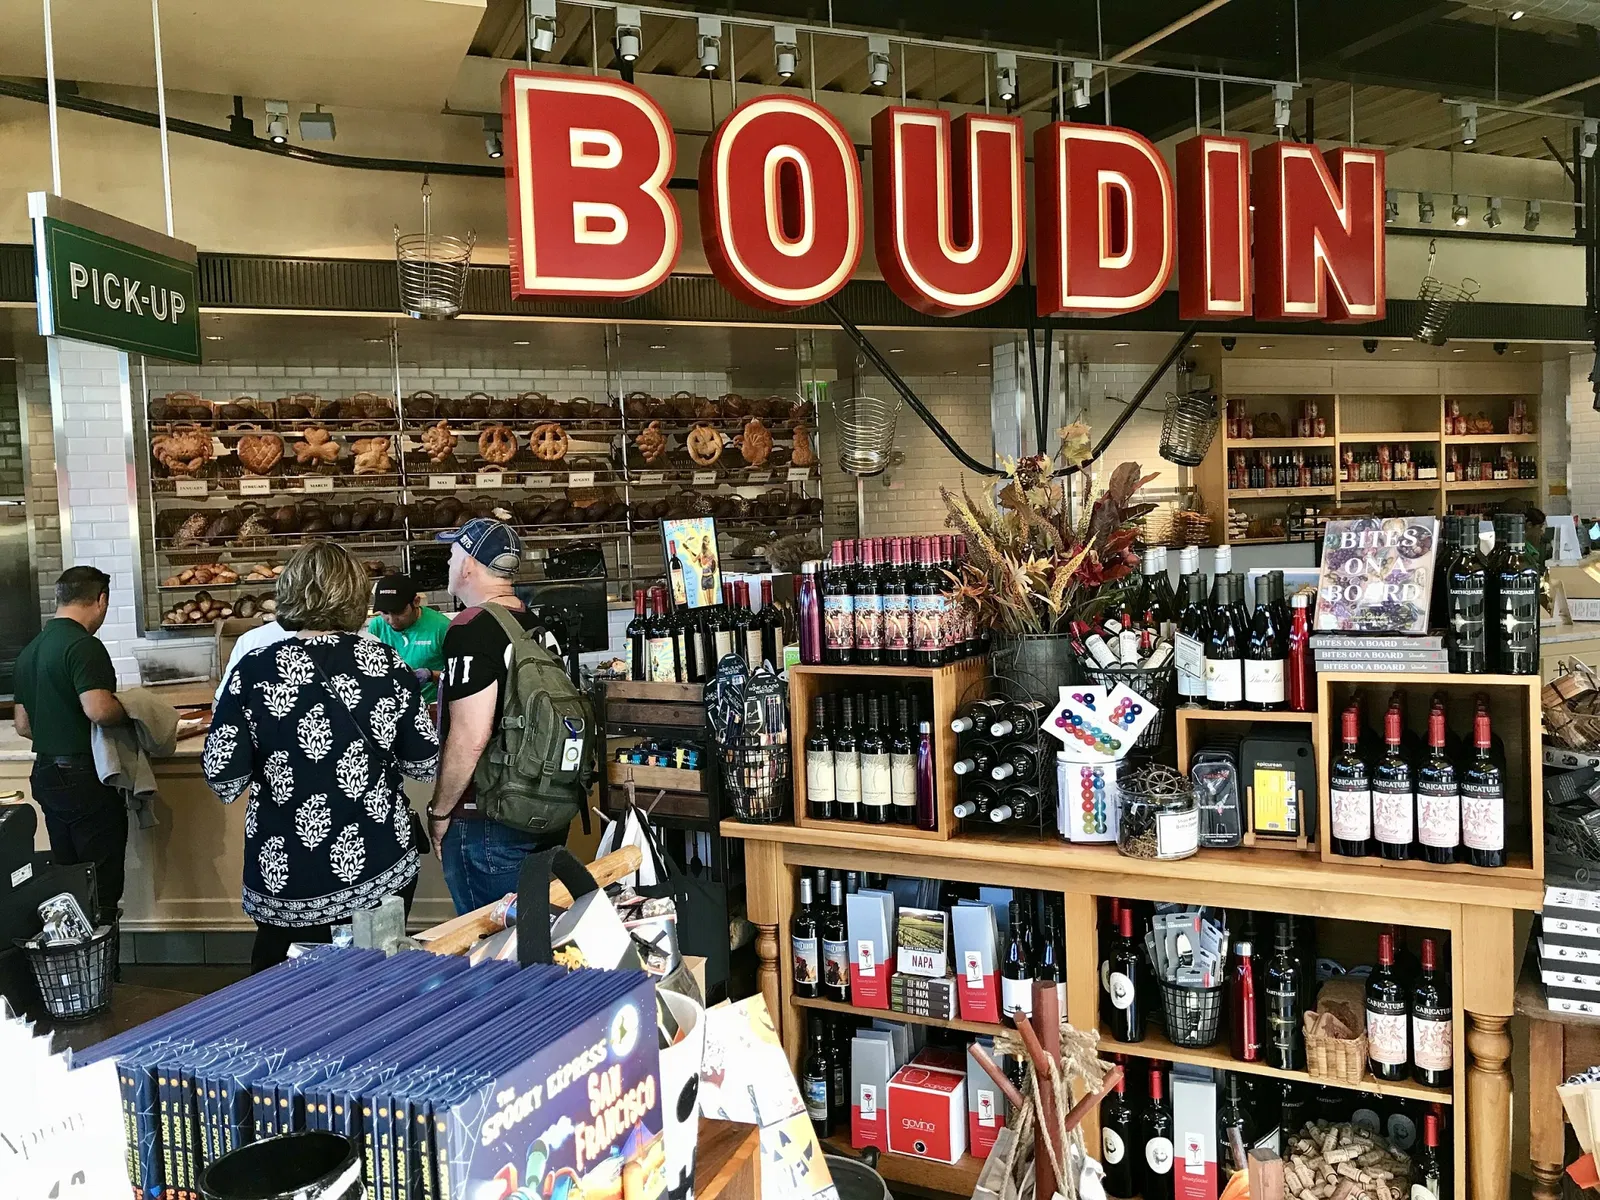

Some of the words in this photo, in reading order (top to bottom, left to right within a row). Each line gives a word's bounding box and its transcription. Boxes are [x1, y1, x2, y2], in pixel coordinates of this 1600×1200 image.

[502, 69, 1387, 323] BOUDIN
[69, 261, 186, 325] PICK-UP
[1340, 528, 1418, 549] BITES
[1345, 554, 1383, 575] ON
[1388, 557, 1408, 574] A
[1322, 583, 1421, 605] BORD
[1316, 639, 1341, 647] BITES
[1371, 651, 1403, 659] BOARD
[1364, 663, 1372, 671] A
[1373, 663, 1405, 671] BOARD
[1331, 777, 1368, 785] CARICATURE
[1372, 779, 1410, 788] CARICATURE
[1418, 782, 1457, 790] CARICATURE
[1461, 783, 1500, 792] CARICATURE
[911, 955, 934, 969] NAPA
[915, 981, 930, 990] NAPA
[915, 990, 929, 999] NAPA
[915, 999, 930, 1008] NAPA
[915, 1008, 930, 1017] NAPA
[1366, 998, 1404, 1010] CARICATURE
[481, 1085, 543, 1146] SPOOKY
[546, 1038, 608, 1100] EXPRESS
[588, 1063, 621, 1117] SAN
[131, 1114, 139, 1147] SPOOKY
[161, 1114, 170, 1147] SPOOKY
[173, 1115, 182, 1148] SPOOKY
[184, 1117, 193, 1150] SPOOKY
[574, 1074, 656, 1172] FRANCISCO
[902, 1118, 935, 1131] govino
[200, 1125, 209, 1159] SPOOKY
[224, 1127, 232, 1153] SPOO
[134, 1149, 142, 1186] EXPRESS
[164, 1149, 173, 1186] EXPRESS
[176, 1151, 185, 1188] EXPRESS
[187, 1152, 195, 1190] EXPRESS
[365, 1147, 374, 1183] SPOOKY
[381, 1148, 391, 1184] SPOOKY
[397, 1150, 406, 1186] SPOOKY
[421, 1155, 431, 1192] SPOOKY
[166, 1189, 175, 1200] SA
[178, 1190, 187, 1200] SA
